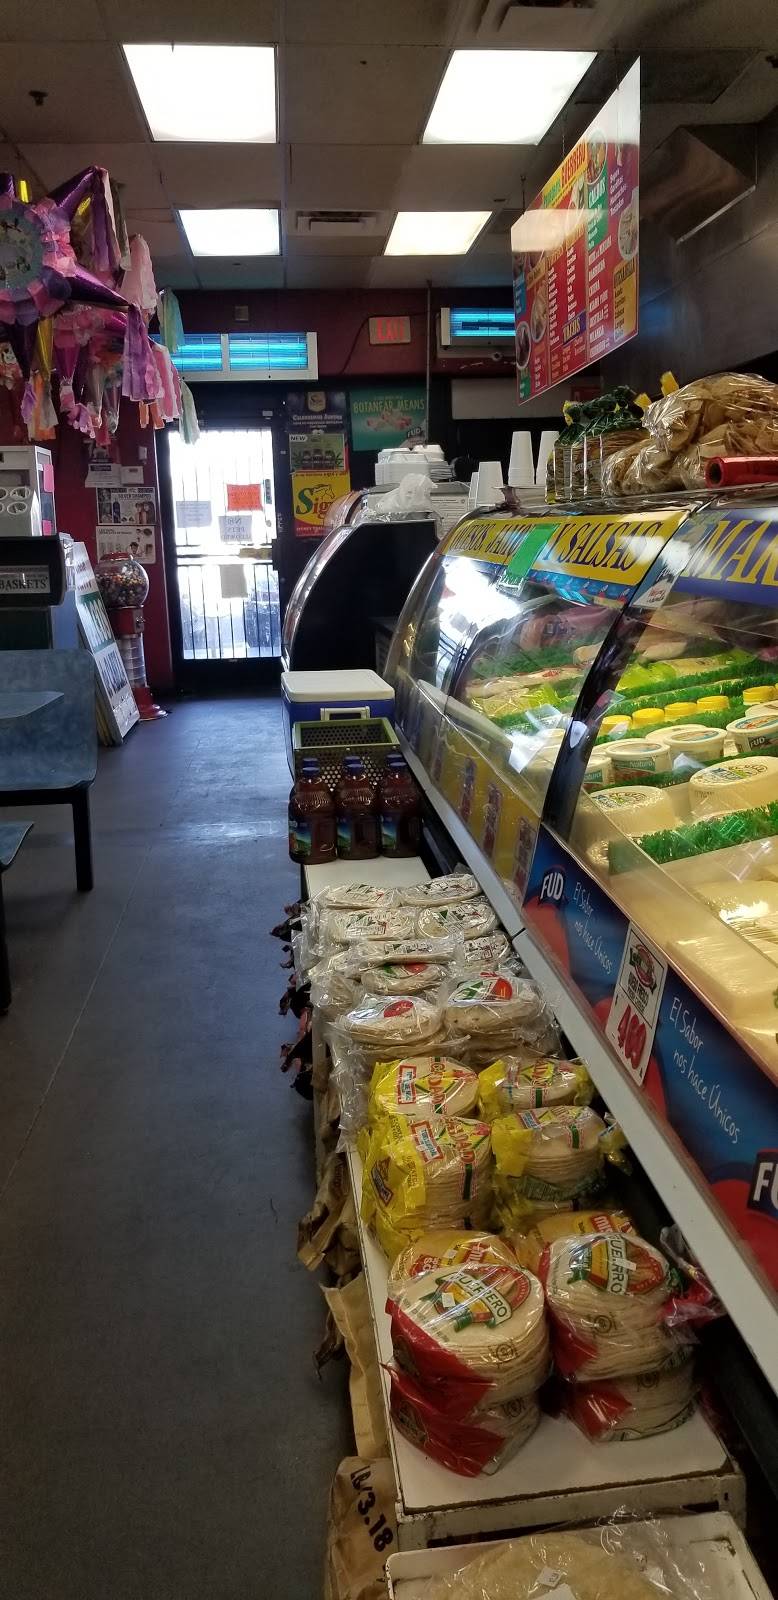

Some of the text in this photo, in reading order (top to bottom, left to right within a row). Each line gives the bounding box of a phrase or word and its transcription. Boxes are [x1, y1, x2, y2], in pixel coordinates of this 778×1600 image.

[562, 316, 582, 343] TACOS
[540, 871, 564, 901] FUD
[669, 995, 705, 1055] El Sabor
[673, 1047, 741, 1145] nos hace Únicos
[450, 1270, 508, 1318] UERRERO
